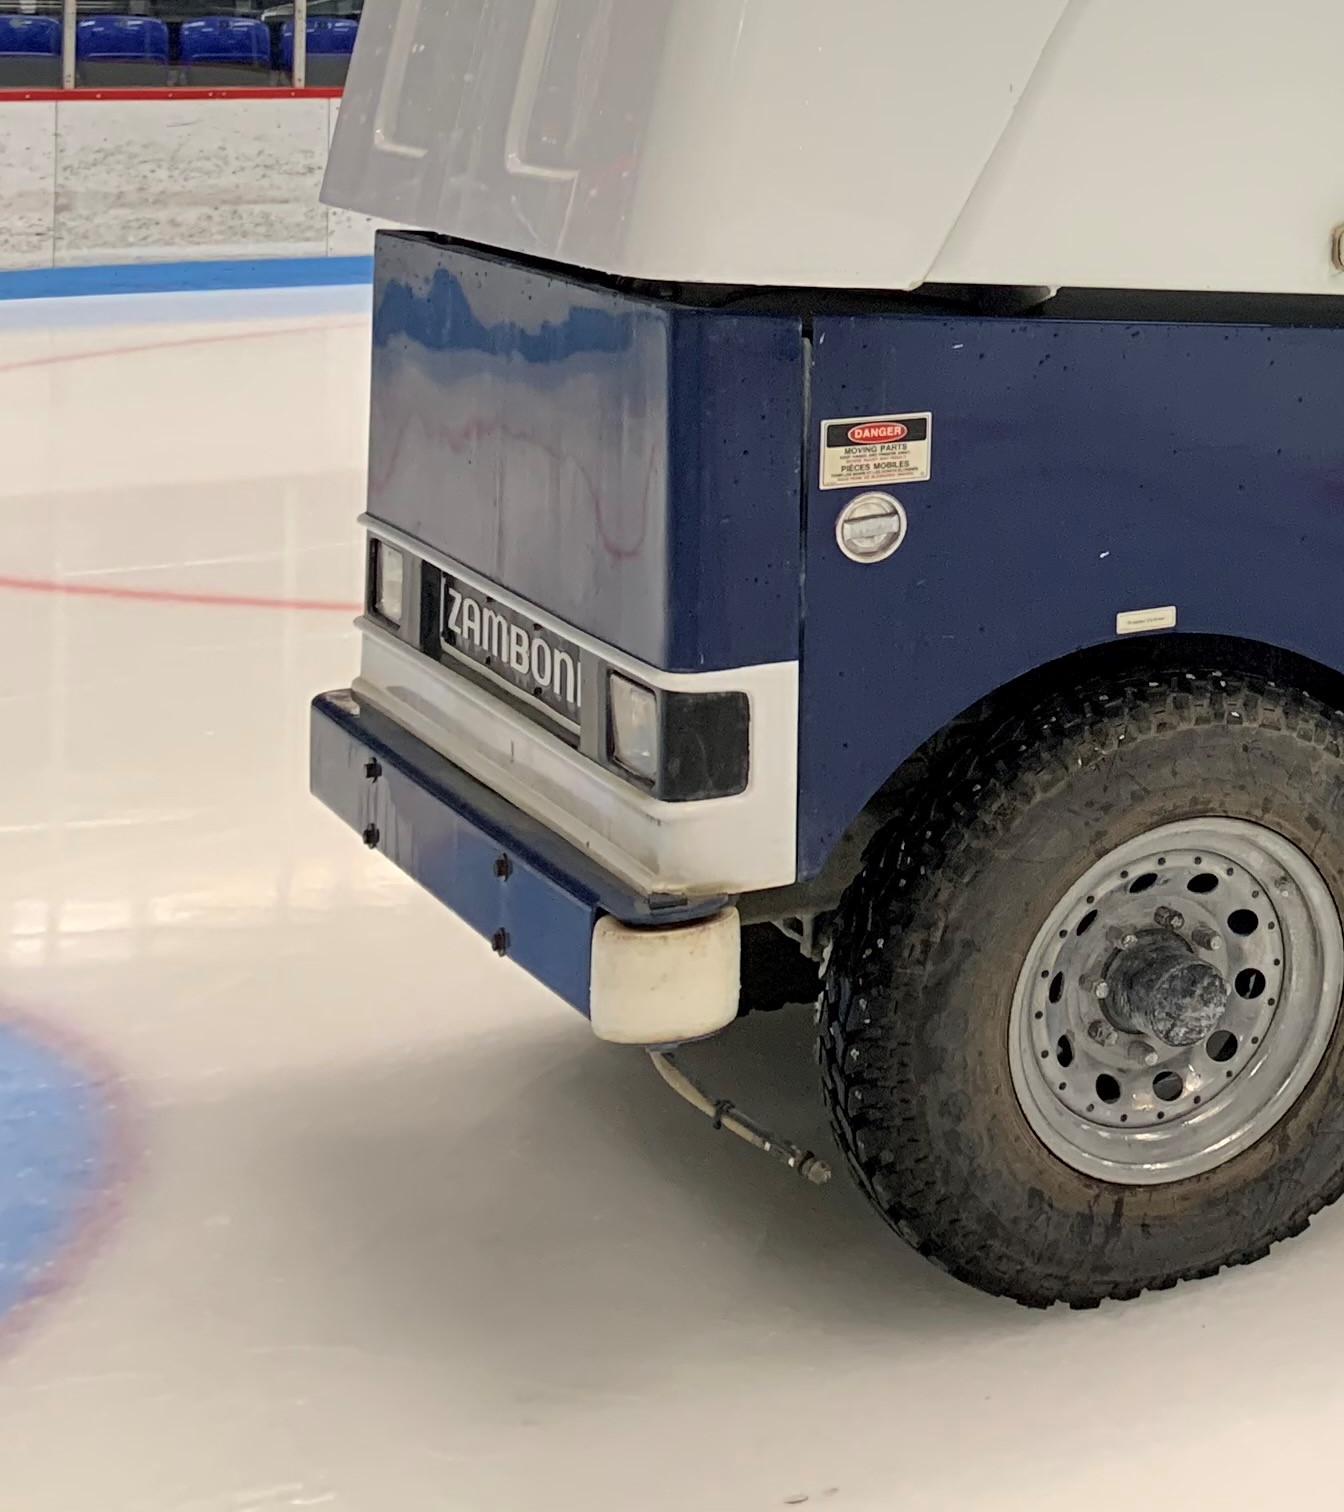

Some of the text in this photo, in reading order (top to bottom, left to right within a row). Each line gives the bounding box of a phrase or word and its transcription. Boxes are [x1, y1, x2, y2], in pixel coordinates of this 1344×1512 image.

[854, 426, 902, 439] DANGER
[844, 443, 908, 455] MOVING PARTS
[873, 460, 910, 470] MOBILES
[447, 587, 582, 708] ZAMBONI
